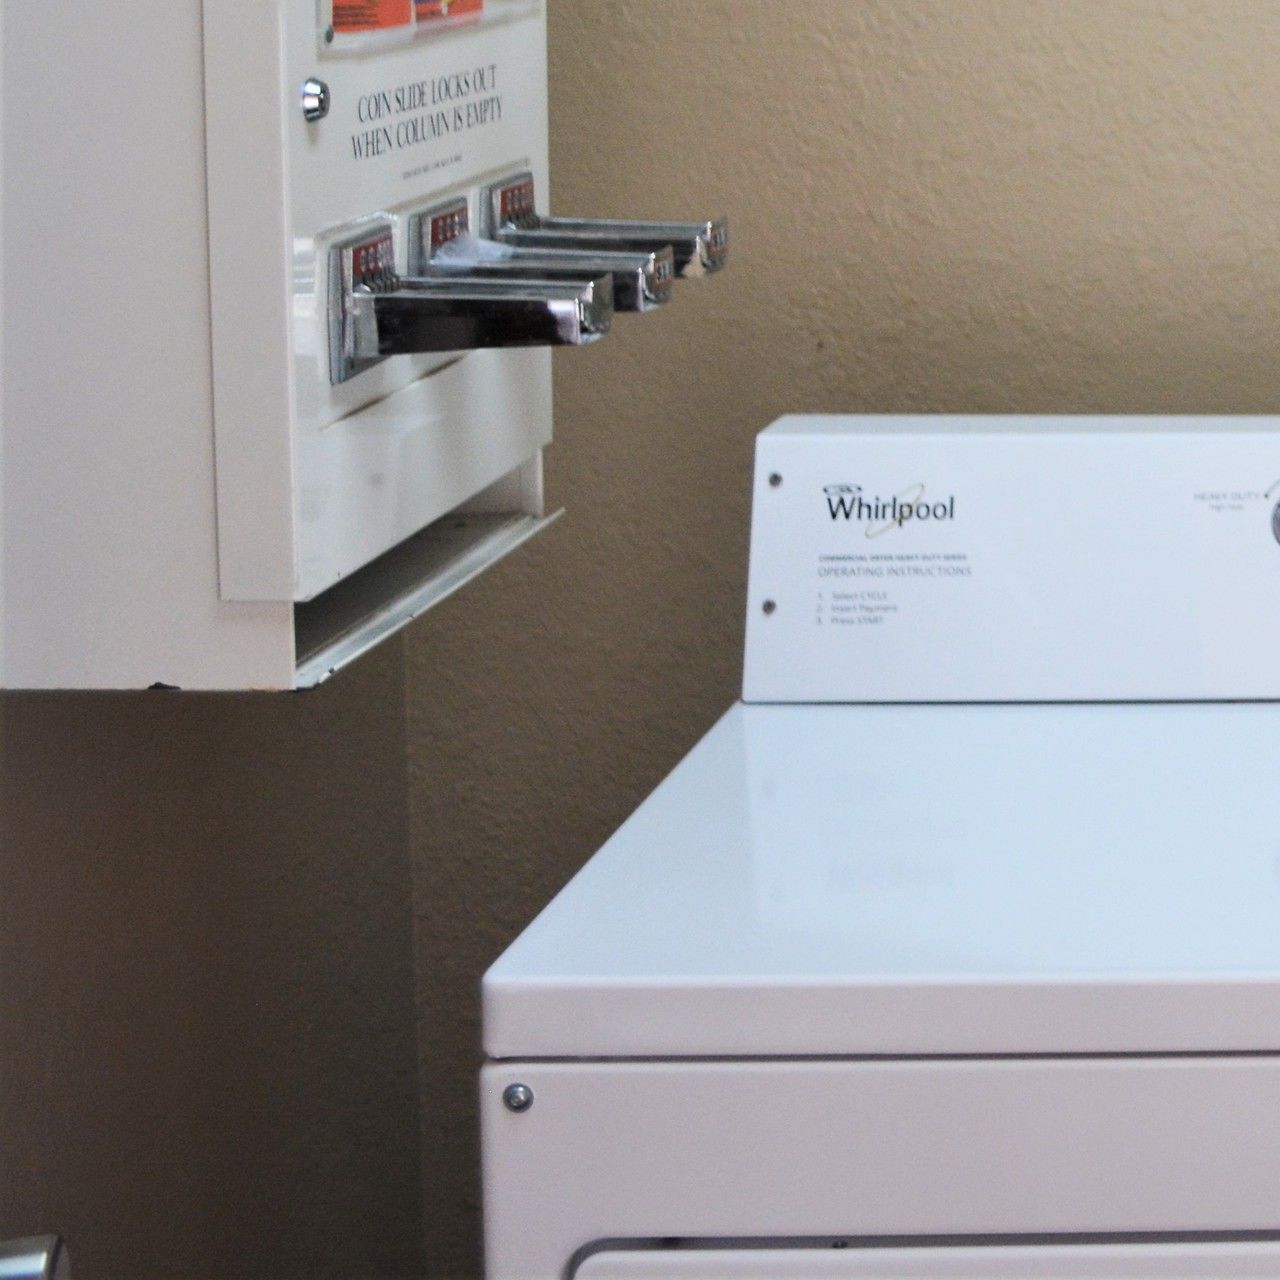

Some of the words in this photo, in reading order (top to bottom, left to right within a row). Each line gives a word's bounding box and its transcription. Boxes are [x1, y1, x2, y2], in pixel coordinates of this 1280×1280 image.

[358, 89, 392, 123] COIN
[395, 80, 427, 113] SLIDE
[431, 72, 470, 105] LOCKS
[473, 64, 497, 91] OUT
[351, 128, 393, 160] WHEN
[396, 112, 450, 150] COLUMN
[453, 107, 463, 132] IS
[466, 96, 503, 129] EMPTY
[827, 495, 955, 527] Whirlpool
